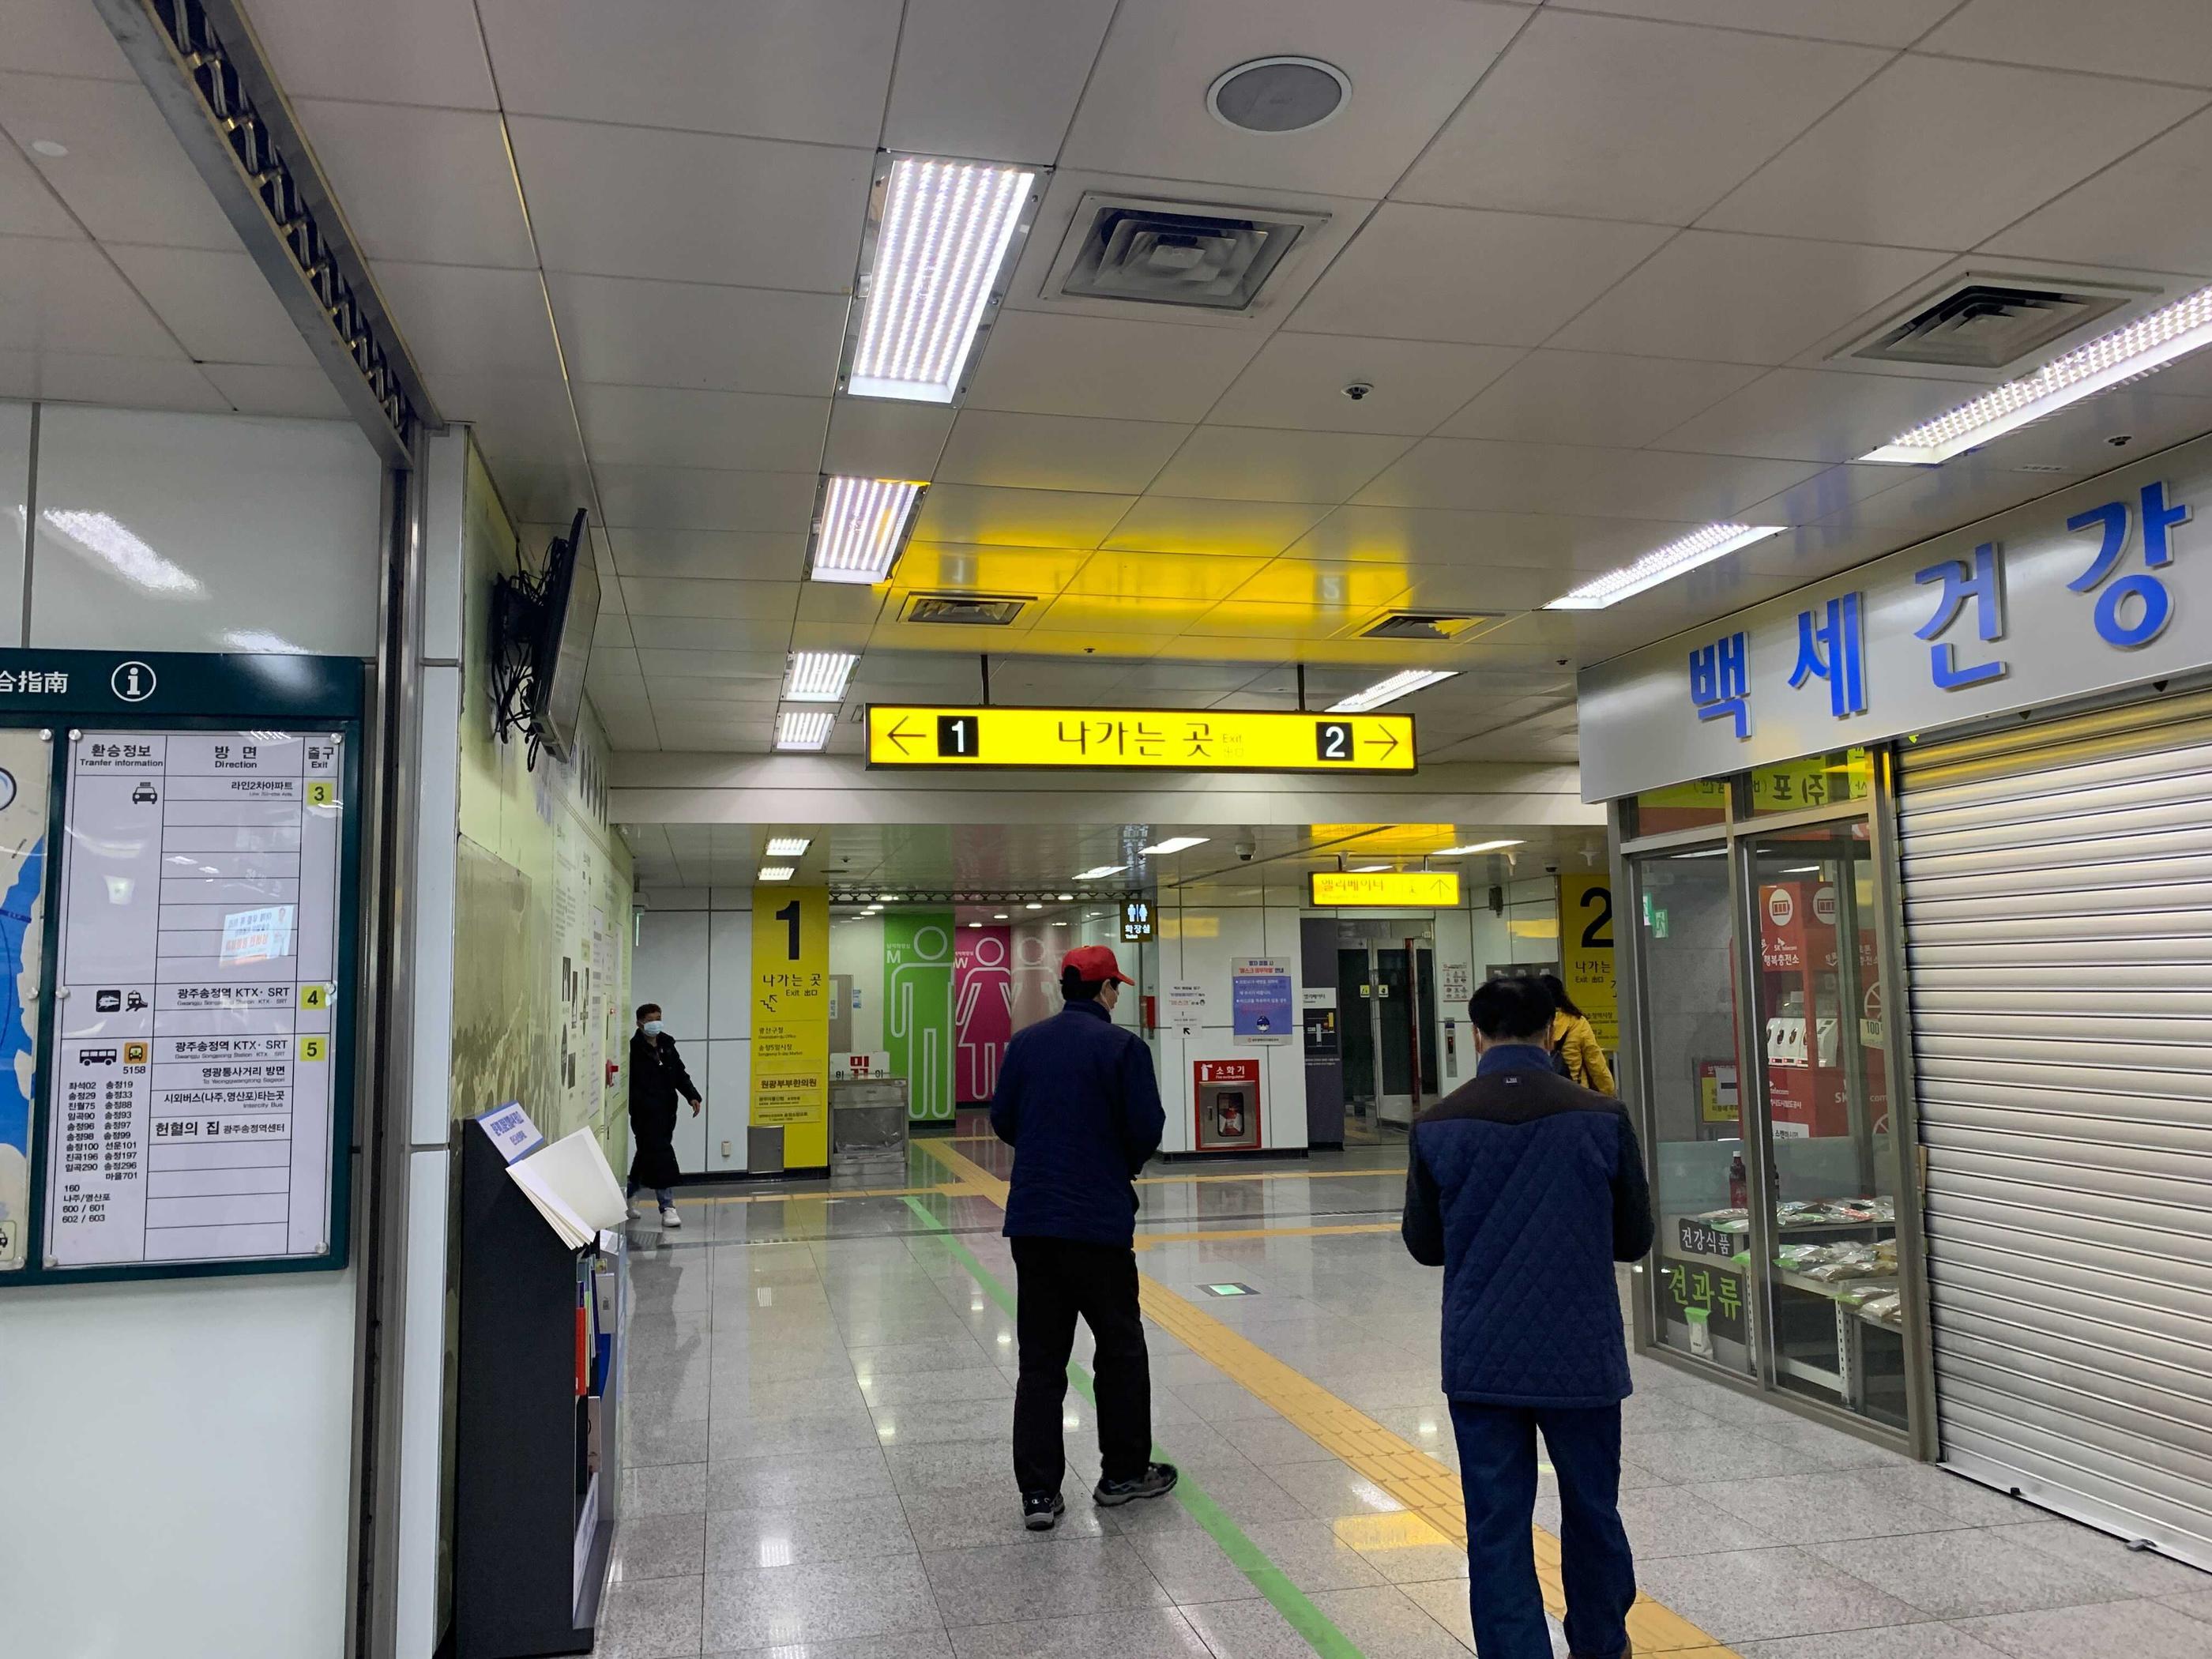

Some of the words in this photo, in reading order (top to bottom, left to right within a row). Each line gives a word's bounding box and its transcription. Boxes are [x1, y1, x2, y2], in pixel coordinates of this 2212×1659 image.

[951, 720, 964, 753] 1
[1058, 720, 1166, 756] 나가는
[1182, 722, 1213, 758] 곳
[1222, 733, 1243, 744] Exit
[1325, 726, 1345, 758] 2
[92, 743, 152, 758] 환승정보
[308, 747, 334, 760] 출구
[231, 781, 294, 791] 라인2차아파트
[314, 787, 325, 801] 3
[1580, 886, 1614, 948] 2
[776, 900, 800, 961] 1
[1124, 924, 1151, 934] 화장실
[886, 950, 901, 964] M
[953, 957, 969, 969] W
[1574, 961, 1612, 973] 나가는
[762, 973, 803, 988] 나가는
[810, 973, 822, 987] 곳
[176, 988, 231, 999] 광주송정역
[267, 988, 290, 997] SRT
[307, 990, 318, 1005] 4
[175, 1040, 230, 1052] 광주송정역
[265, 1040, 288, 1049] SRT
[307, 1042, 318, 1057] 5
[122, 1066, 146, 1074] 5158
[201, 1066, 261, 1078] 영광통사거리
[265, 1066, 285, 1076] 방면
[760, 1078, 818, 1089] 원광부부한의원
[68, 1092, 96, 1100] 송정29
[67, 1123, 95, 1131] 송정96
[155, 1122, 198, 1136] 헌혈의
[206, 1121, 220, 1135] 집
[223, 1123, 285, 1134] 광주송정역센터
[66, 1133, 94, 1142] 송정98
[66, 1142, 100, 1152] 송정100
[105, 1172, 137, 1181] 마을701
[63, 1193, 111, 1202] 나주/영산포
[1681, 1226, 1730, 1255] 건강식품
[1667, 1264, 1742, 1322] 견과류
